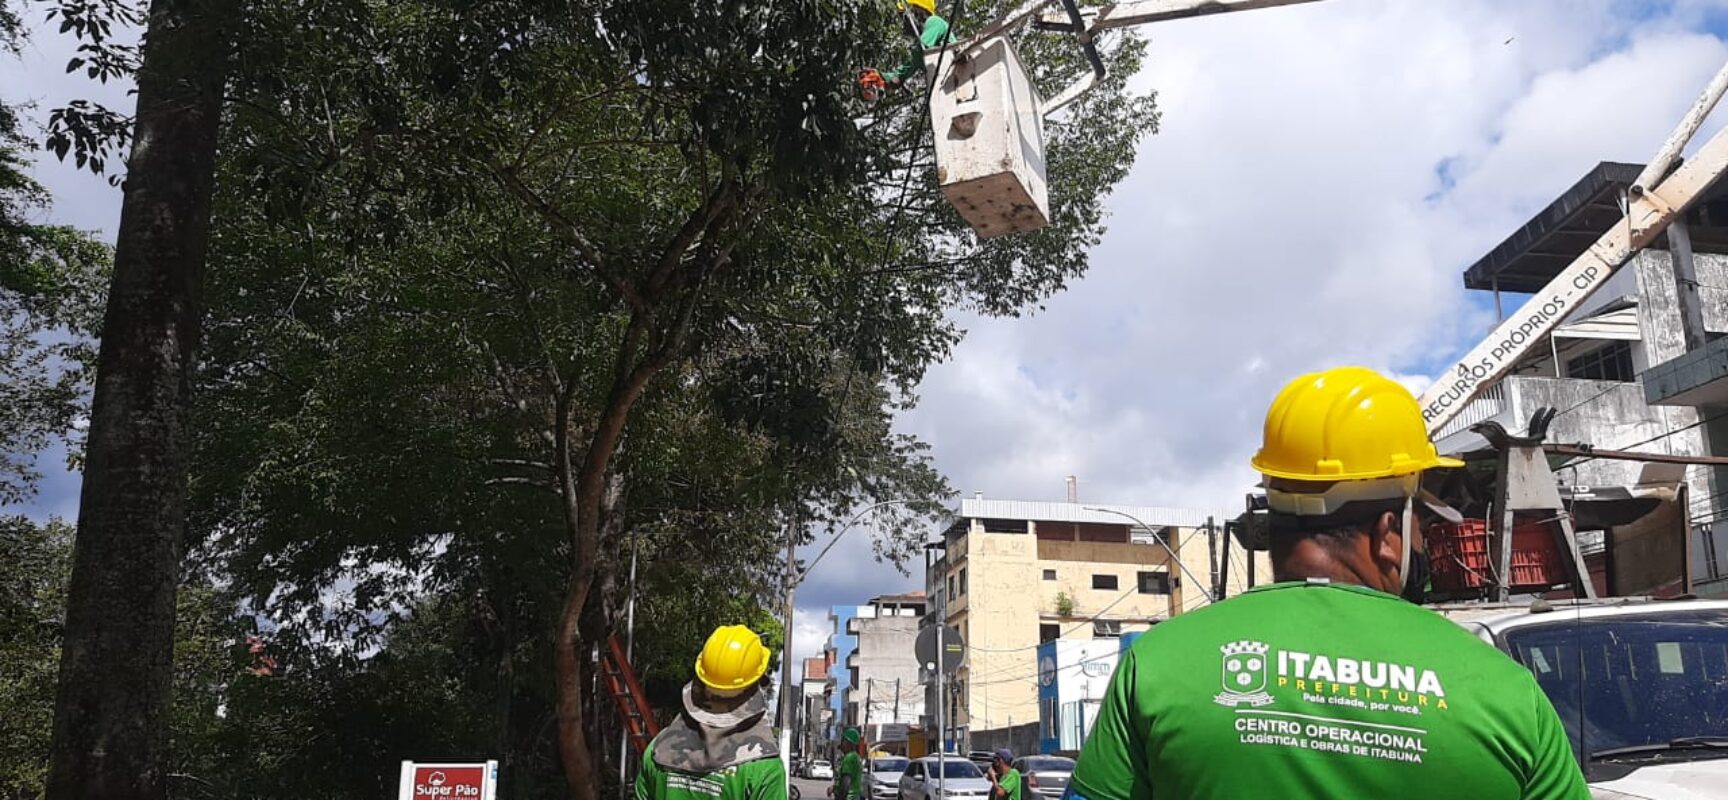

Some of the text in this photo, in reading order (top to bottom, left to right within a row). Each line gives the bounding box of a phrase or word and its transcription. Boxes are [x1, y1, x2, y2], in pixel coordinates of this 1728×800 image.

[1421, 358, 1495, 423] RECURSOS
[1491, 294, 1566, 362] PRÓPRIOS
[1573, 265, 1599, 290] CIP
[1277, 650, 1445, 697] ITABUNA
[1278, 676, 1448, 709] PREFEITURA
[1303, 692, 1423, 715] Pela cidade, por você.
[1235, 718, 1428, 752] CENTRO OPERACIONAL
[1240, 732, 1423, 763] LOGÍSTICA E OBRAS DE ITABUNA
[416, 784, 479, 800] Super Pão
